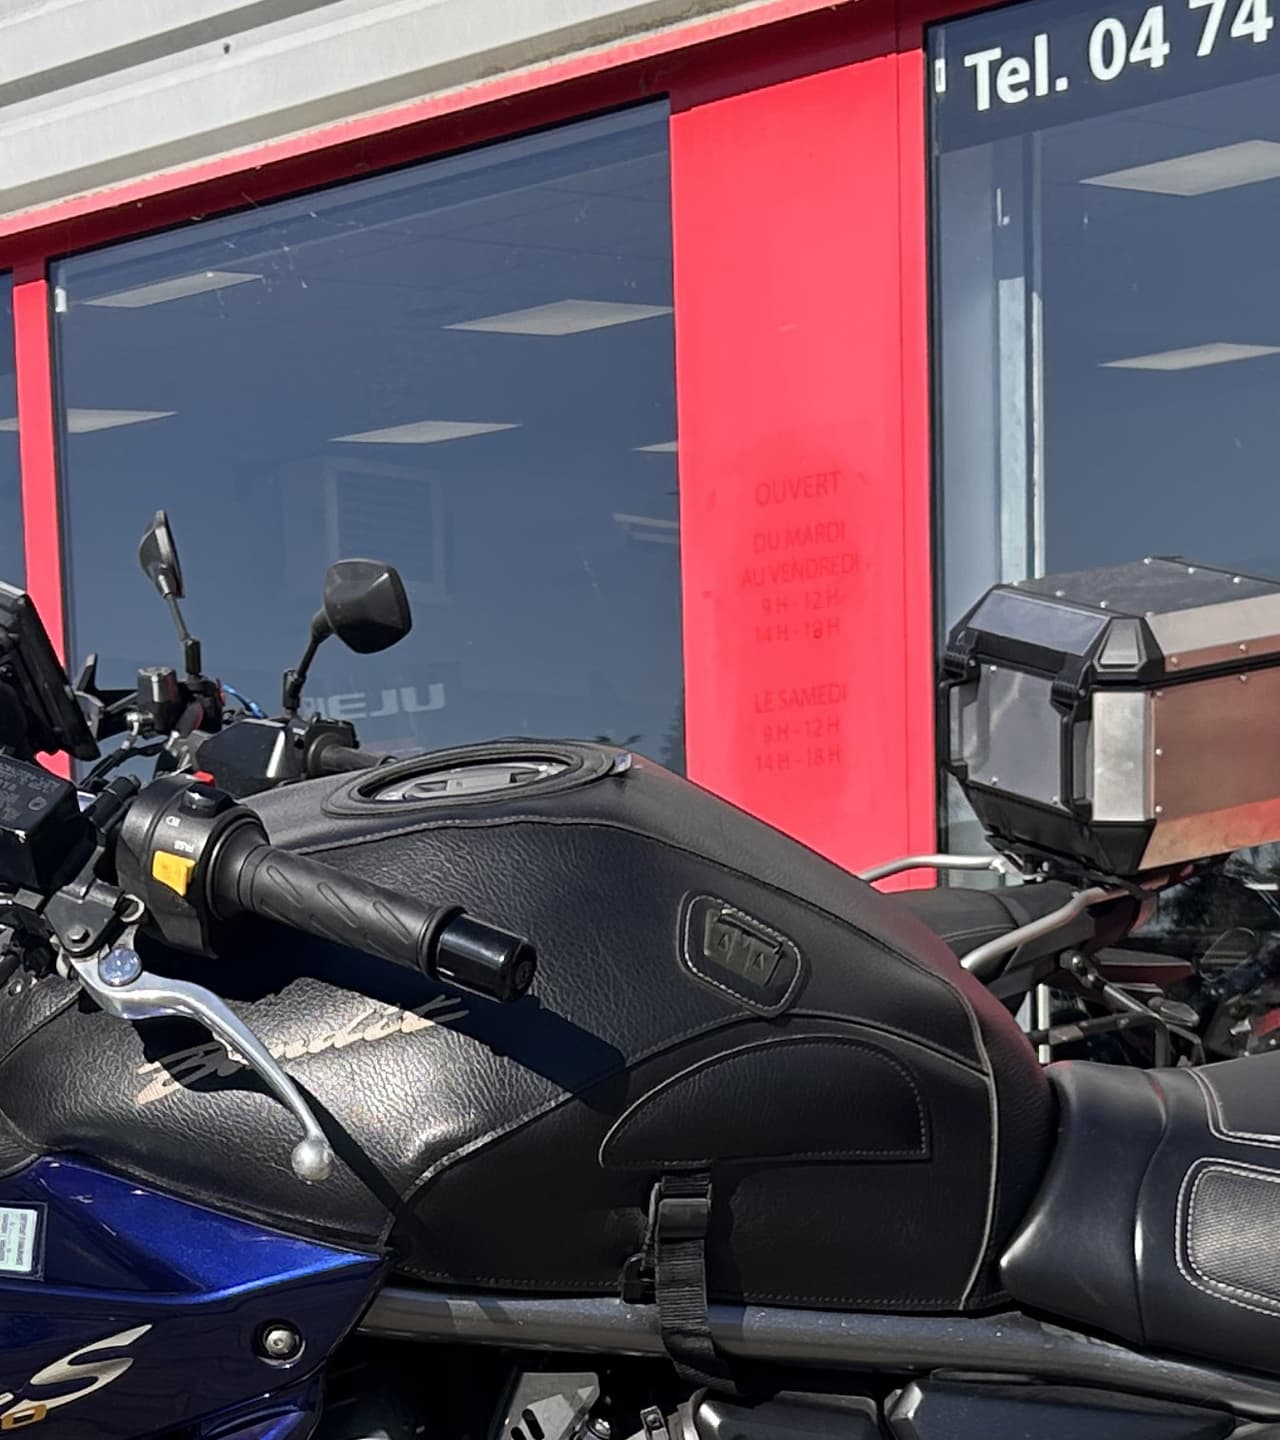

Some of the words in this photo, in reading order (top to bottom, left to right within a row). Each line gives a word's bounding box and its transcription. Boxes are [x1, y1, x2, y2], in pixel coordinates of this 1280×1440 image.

[963, 33, 1069, 112] Tel.
[1088, 4, 1171, 82] 04
[1187, 0, 1275, 57] 74
[754, 471, 841, 507] OUVERT
[784, 520, 846, 546] MARDI
[777, 682, 847, 708] SAMEDI
[8, 1323, 153, 1414] S
